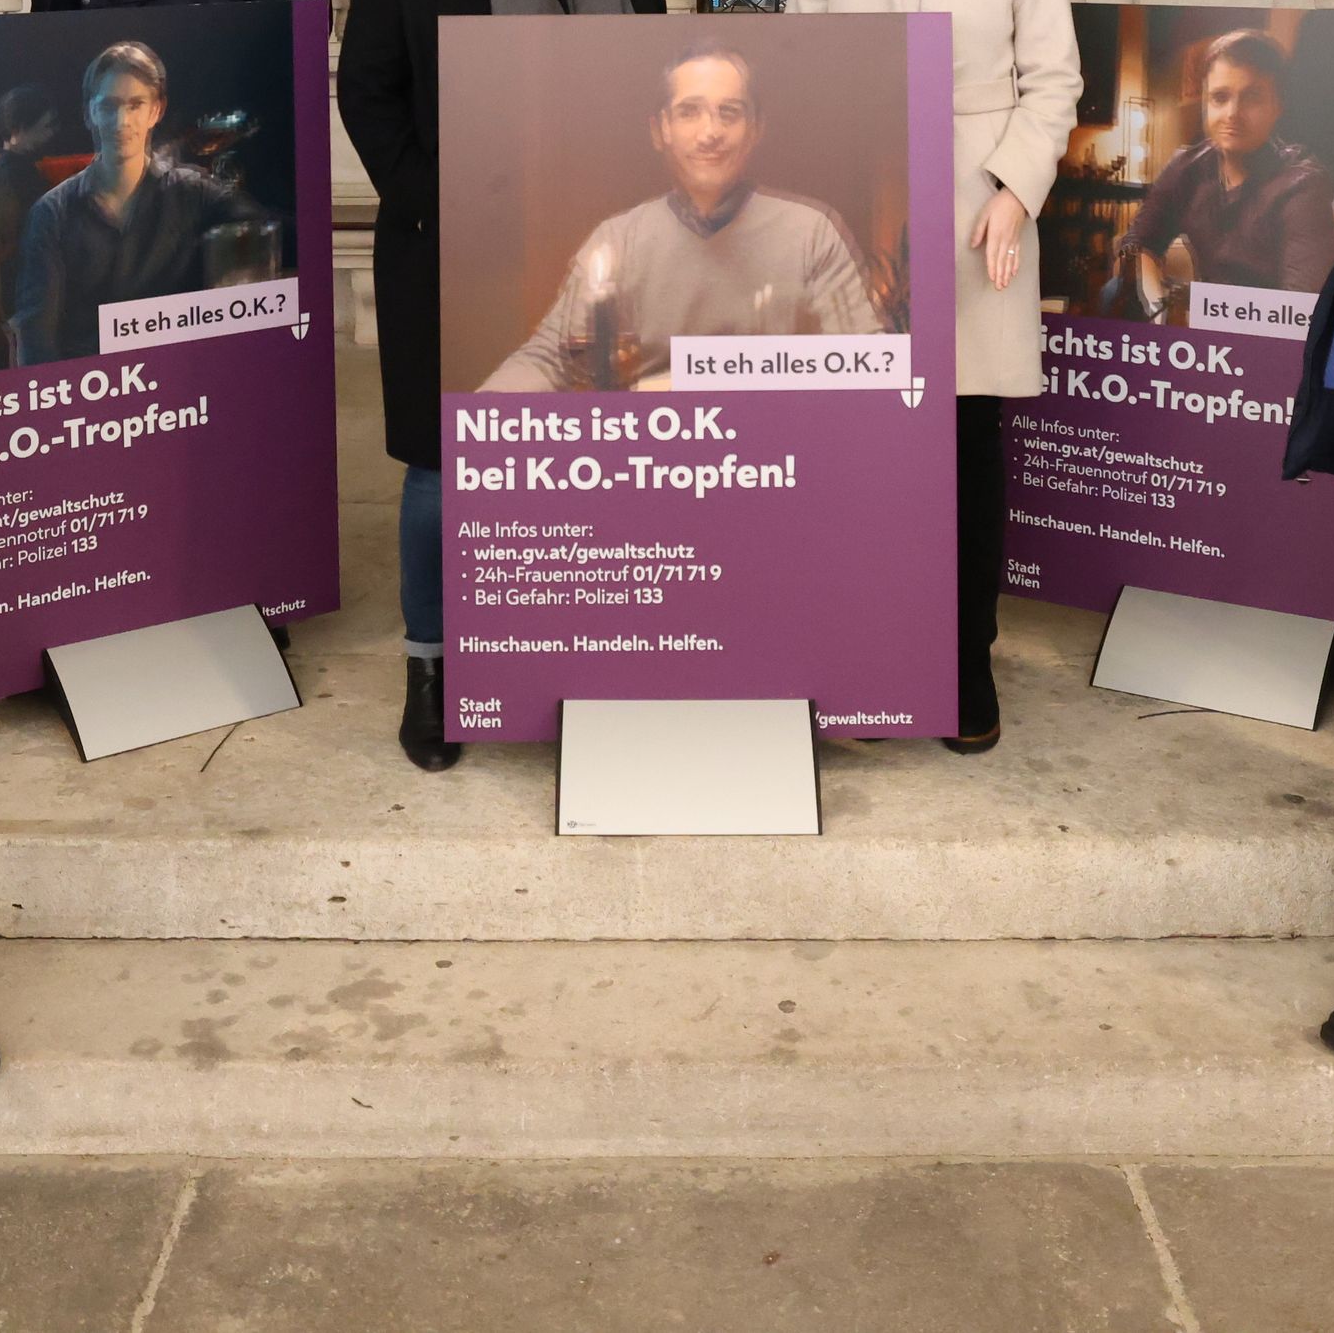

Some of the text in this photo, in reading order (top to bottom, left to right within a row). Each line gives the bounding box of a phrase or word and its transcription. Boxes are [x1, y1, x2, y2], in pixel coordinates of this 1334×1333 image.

[113, 293, 286, 337] Ist eh alles O.K.?
[1203, 298, 1229, 318] Ist
[1234, 302, 1261, 322] eh
[687, 351, 895, 375] Ist eh alles O.K.?
[1041, 325, 1244, 376] ichts ist O.K.
[28, 379, 72, 411] ist
[80, 363, 158, 401] O.K.
[1067, 369, 1295, 426] K.O.-Tropfen!
[456, 406, 737, 442] Nichts ist O.K.
[1012, 415, 1120, 443] Alle Infos unter:
[1024, 436, 1204, 474] wien.gv.at/gewaltschutz
[456, 454, 796, 498] bei K.O.-Tropfen!
[1024, 454, 1148, 485] 24h-Frauennotruf
[1023, 472, 1175, 509] Bei Gefahr: Polizei 133
[458, 521, 594, 538] Alle Infos unter:
[1009, 508, 1225, 558] Hinschauen. Handeln. Helfen.
[18, 542, 67, 565] Polizei
[71, 536, 98, 554] 133
[474, 542, 695, 564] wien.gv.at/gewaltschutz
[474, 566, 630, 583] 24h-Frauennotruf
[1007, 572, 1040, 589] Wien
[1008, 559, 1041, 576] Stadt
[18, 582, 91, 609] Handeln.
[95, 569, 151, 591] Helfen.
[475, 588, 663, 605] Bei Gefahr: Polizei 133
[459, 634, 723, 652] Hinschauen. Handeln. Helfen.
[459, 697, 502, 712] Stadt
[459, 713, 502, 728] Wien
